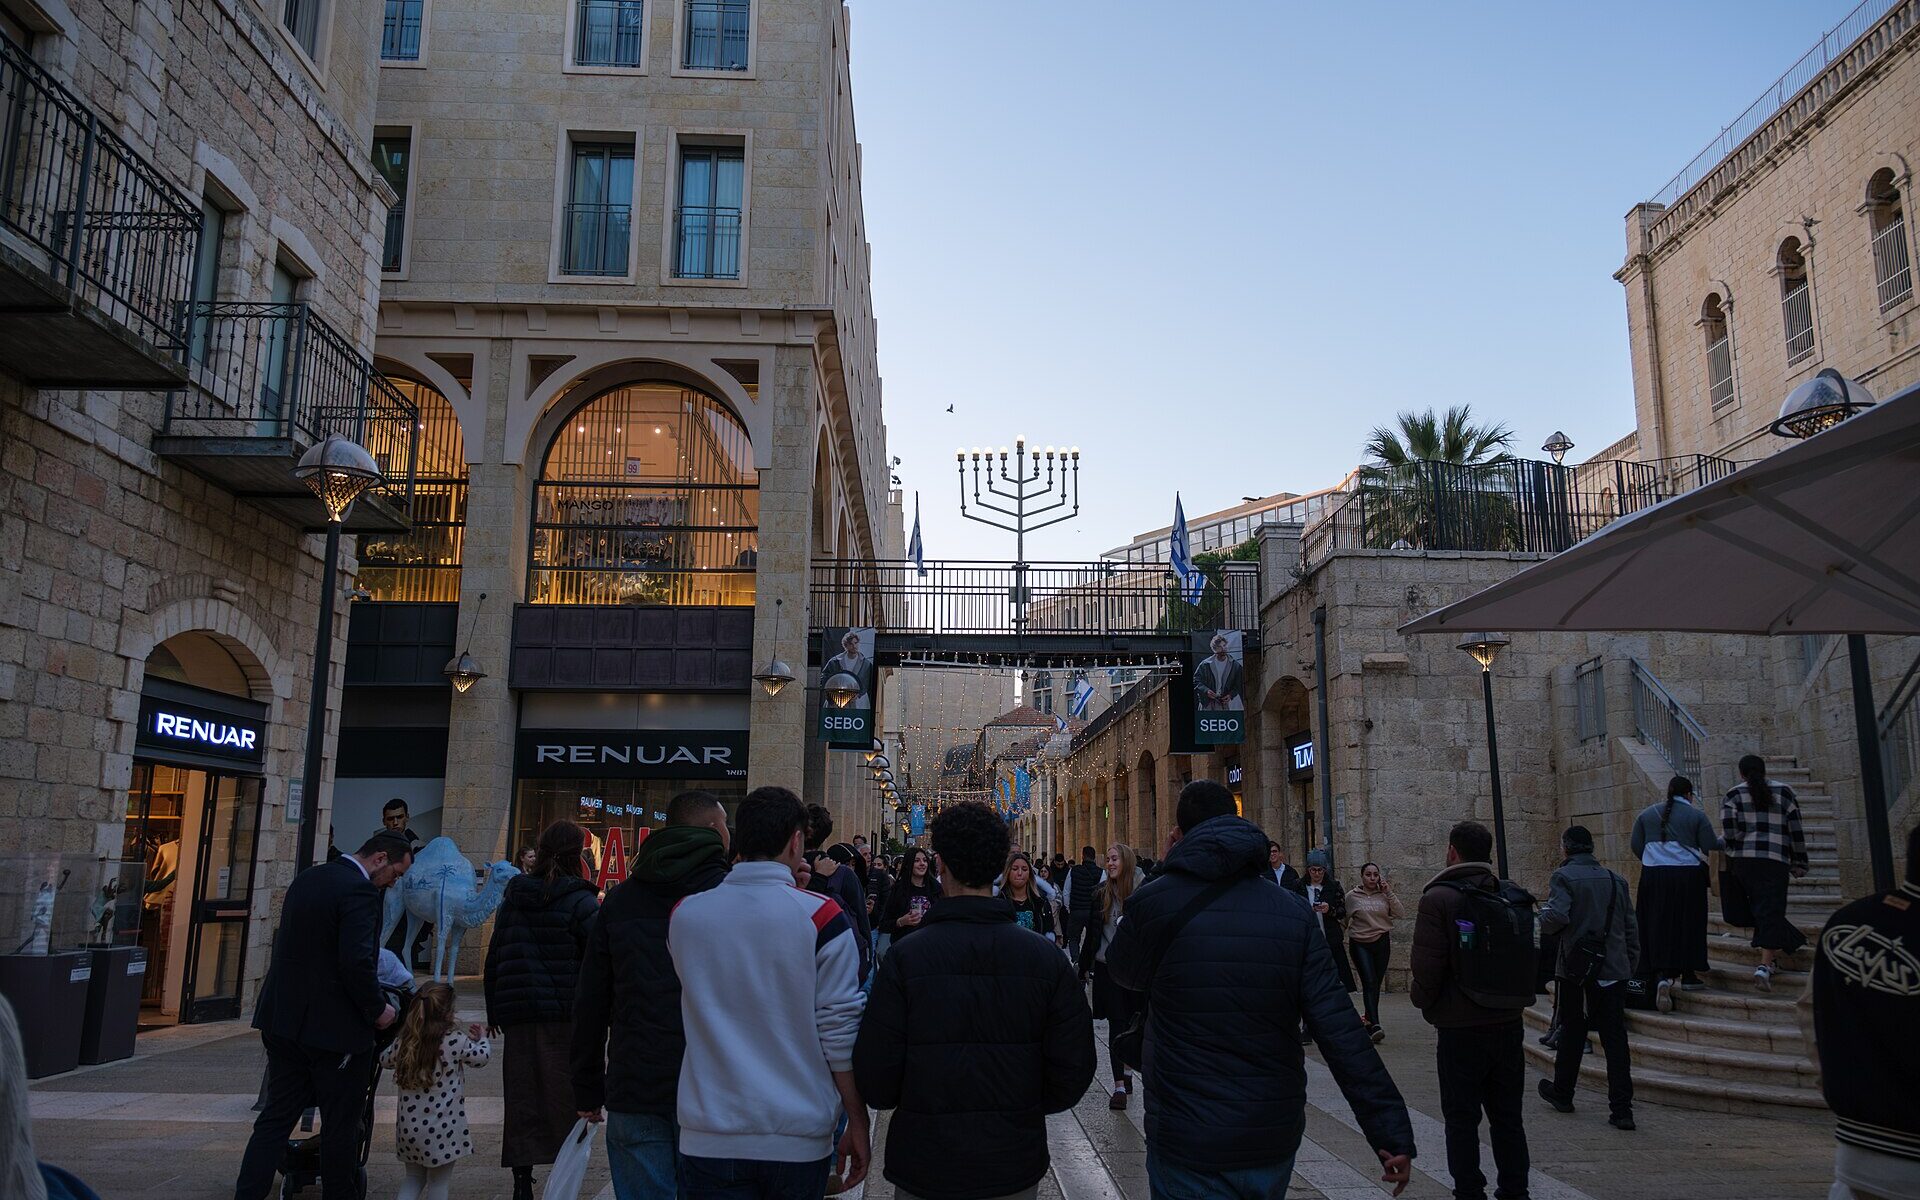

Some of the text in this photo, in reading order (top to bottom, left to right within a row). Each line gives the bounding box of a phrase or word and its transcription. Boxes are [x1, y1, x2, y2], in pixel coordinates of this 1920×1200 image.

[557, 499, 614, 511] MANGO
[157, 713, 256, 749] RENUAR
[824, 716, 865, 731] SEBO
[1200, 718, 1239, 732] SEBO
[536, 745, 731, 764] RENUAR
[1293, 741, 1314, 769] TUM
